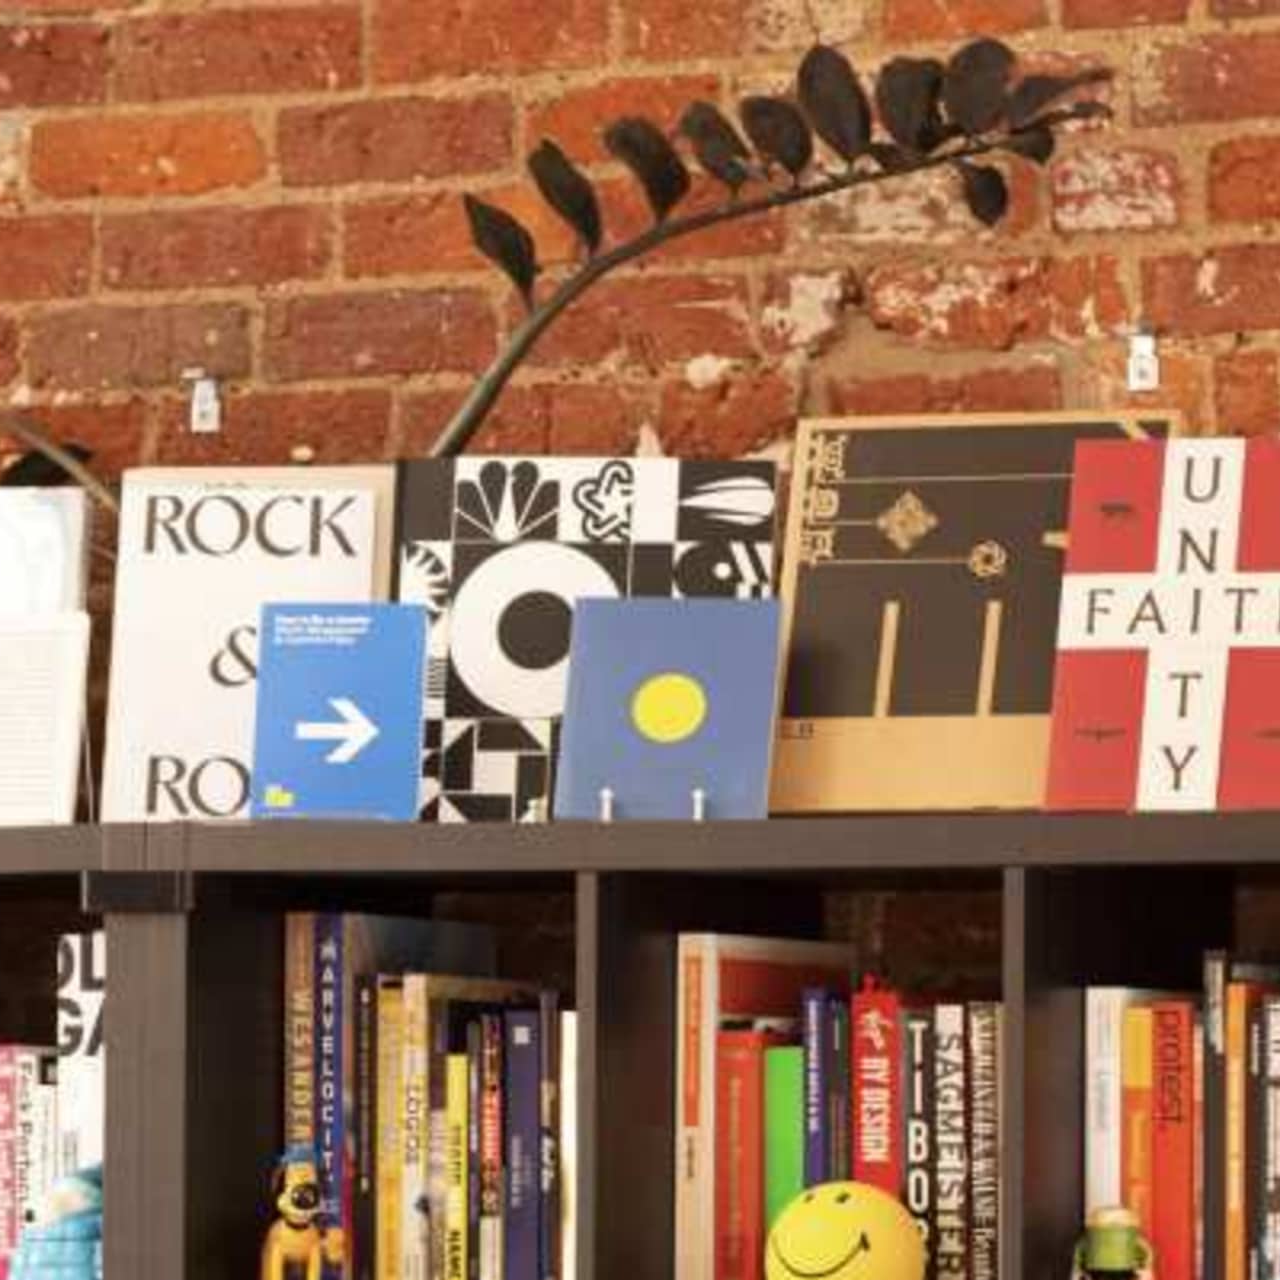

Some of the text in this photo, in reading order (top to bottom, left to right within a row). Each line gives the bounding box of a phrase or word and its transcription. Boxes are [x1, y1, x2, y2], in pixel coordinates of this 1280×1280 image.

[144, 494, 357, 558] ROCK
[145, 755, 250, 817] RO
[292, 1054, 314, 1142] ANDER
[319, 938, 337, 1183] MARVELOCIT
[906, 1020, 931, 1241] TIBO
[935, 1032, 965, 1275] SAGMEISTER
